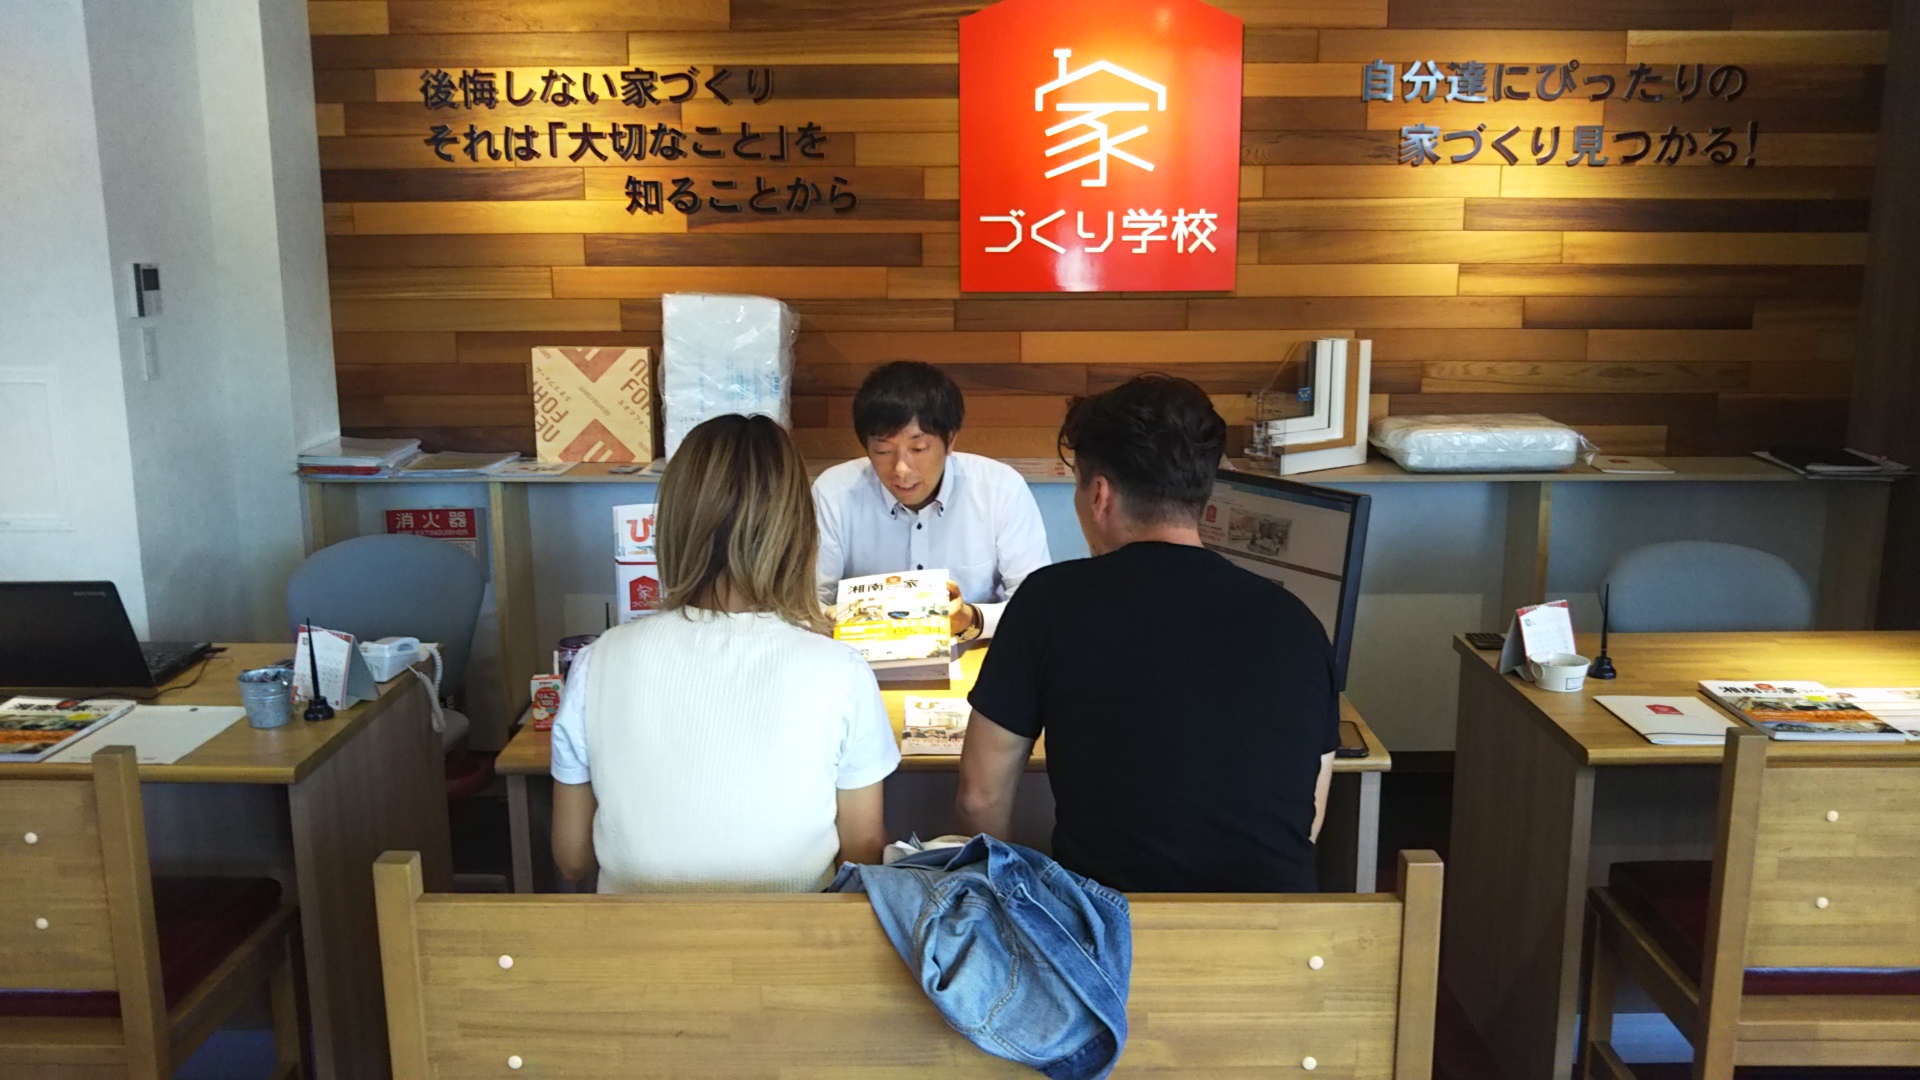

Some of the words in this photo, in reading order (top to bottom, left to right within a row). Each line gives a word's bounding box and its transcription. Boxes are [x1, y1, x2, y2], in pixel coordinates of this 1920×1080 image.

[420, 67, 774, 108] 後悔しない家づくり
[1362, 59, 1747, 103] 自分達にぴったりの
[1035, 48, 1166, 187] 家
[424, 121, 828, 162] それは「大切なこと」を
[625, 174, 857, 215] 知ることから
[980, 208, 1217, 254] づくり学校
[396, 511, 467, 529] 消火器
